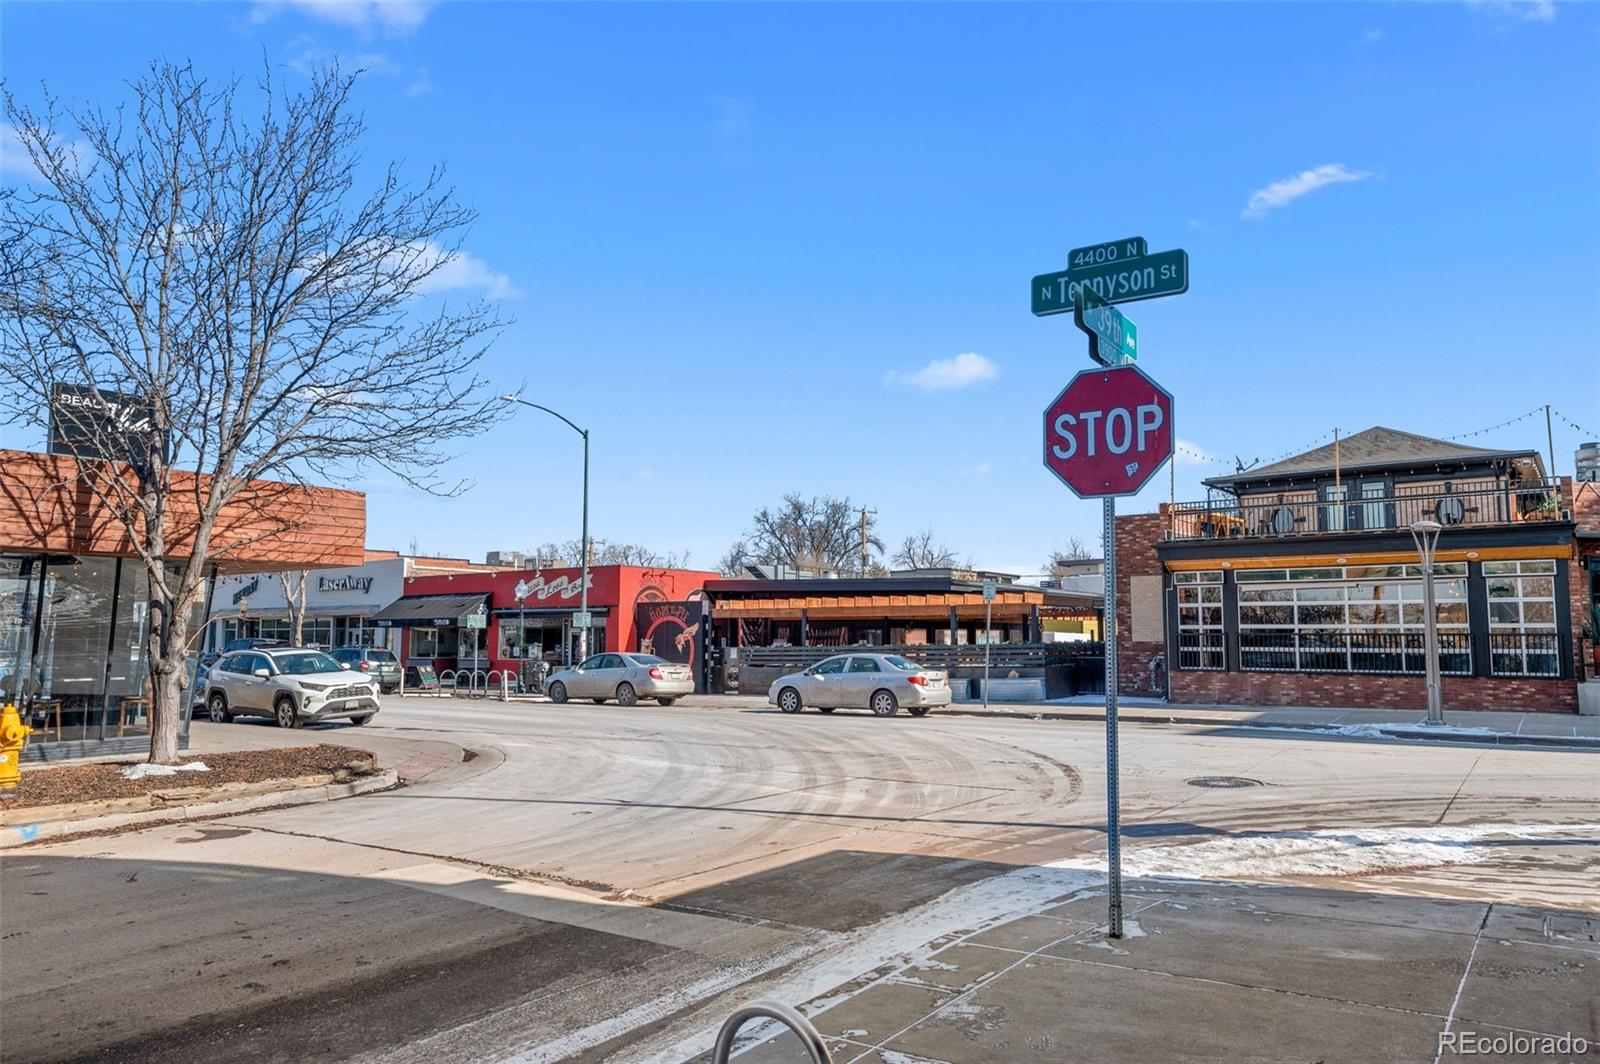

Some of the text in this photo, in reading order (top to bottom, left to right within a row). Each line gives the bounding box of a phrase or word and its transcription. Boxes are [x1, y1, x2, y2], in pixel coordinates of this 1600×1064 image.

[1074, 242, 1137, 266] 4400 N
[1041, 264, 1177, 304] N Tennyson St
[1097, 303, 1123, 346] 39th
[1053, 404, 1164, 460] STOP
[317, 575, 374, 594] LaserAway
